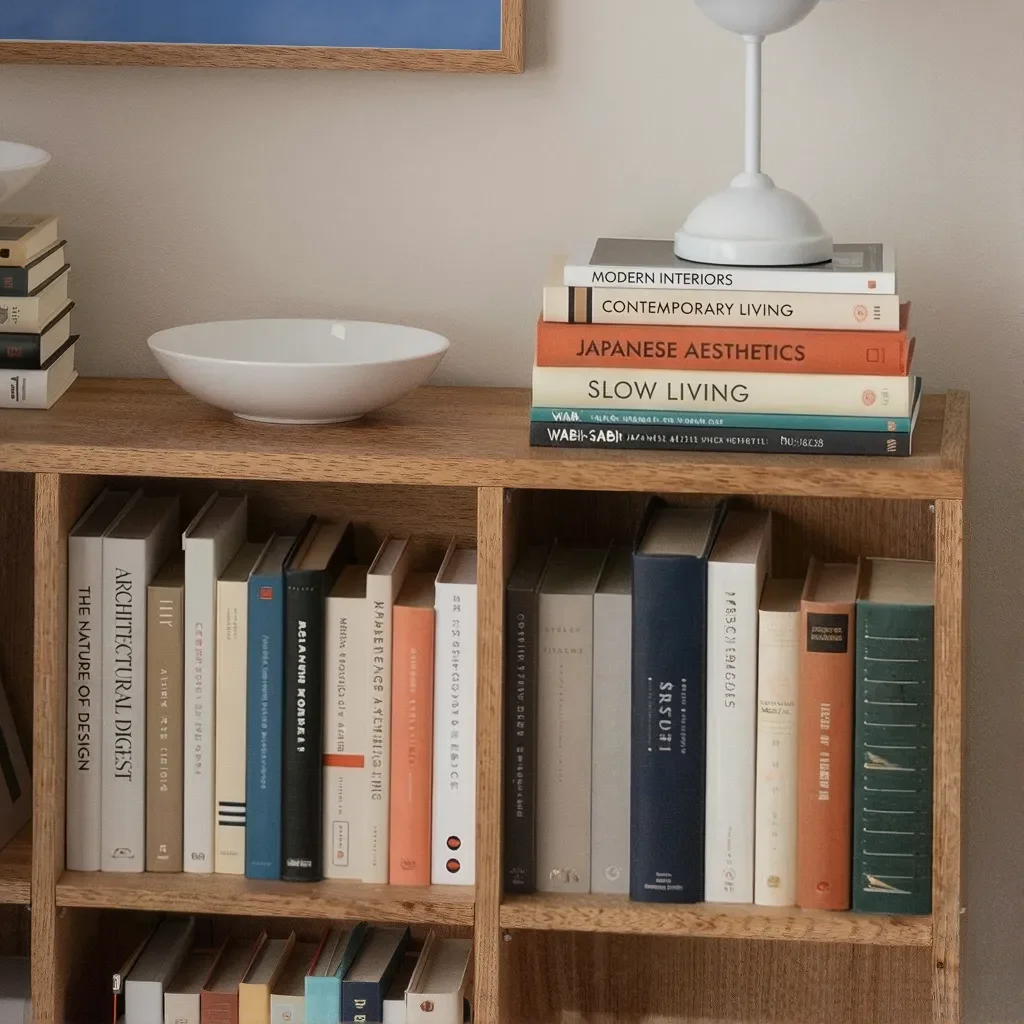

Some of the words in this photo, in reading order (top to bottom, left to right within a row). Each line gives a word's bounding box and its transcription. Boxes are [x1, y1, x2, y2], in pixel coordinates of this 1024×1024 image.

[591, 271, 655, 284] MODERN
[659, 272, 733, 286] INTERIORS
[602, 299, 734, 316] CONTEMPORARY
[739, 303, 794, 317] LIVING
[575, 339, 677, 359] JAPANESE
[683, 342, 806, 362] AESTHETICS
[588, 379, 657, 400] SLOW
[667, 382, 749, 403] LIVING
[78, 585, 91, 616] THE
[77, 621, 91, 681] NATURE
[114, 567, 133, 715] ARCHITECTURAL
[77, 684, 91, 707] OF
[77, 712, 91, 771] DESIGN
[114, 719, 133, 782] DIGEST
